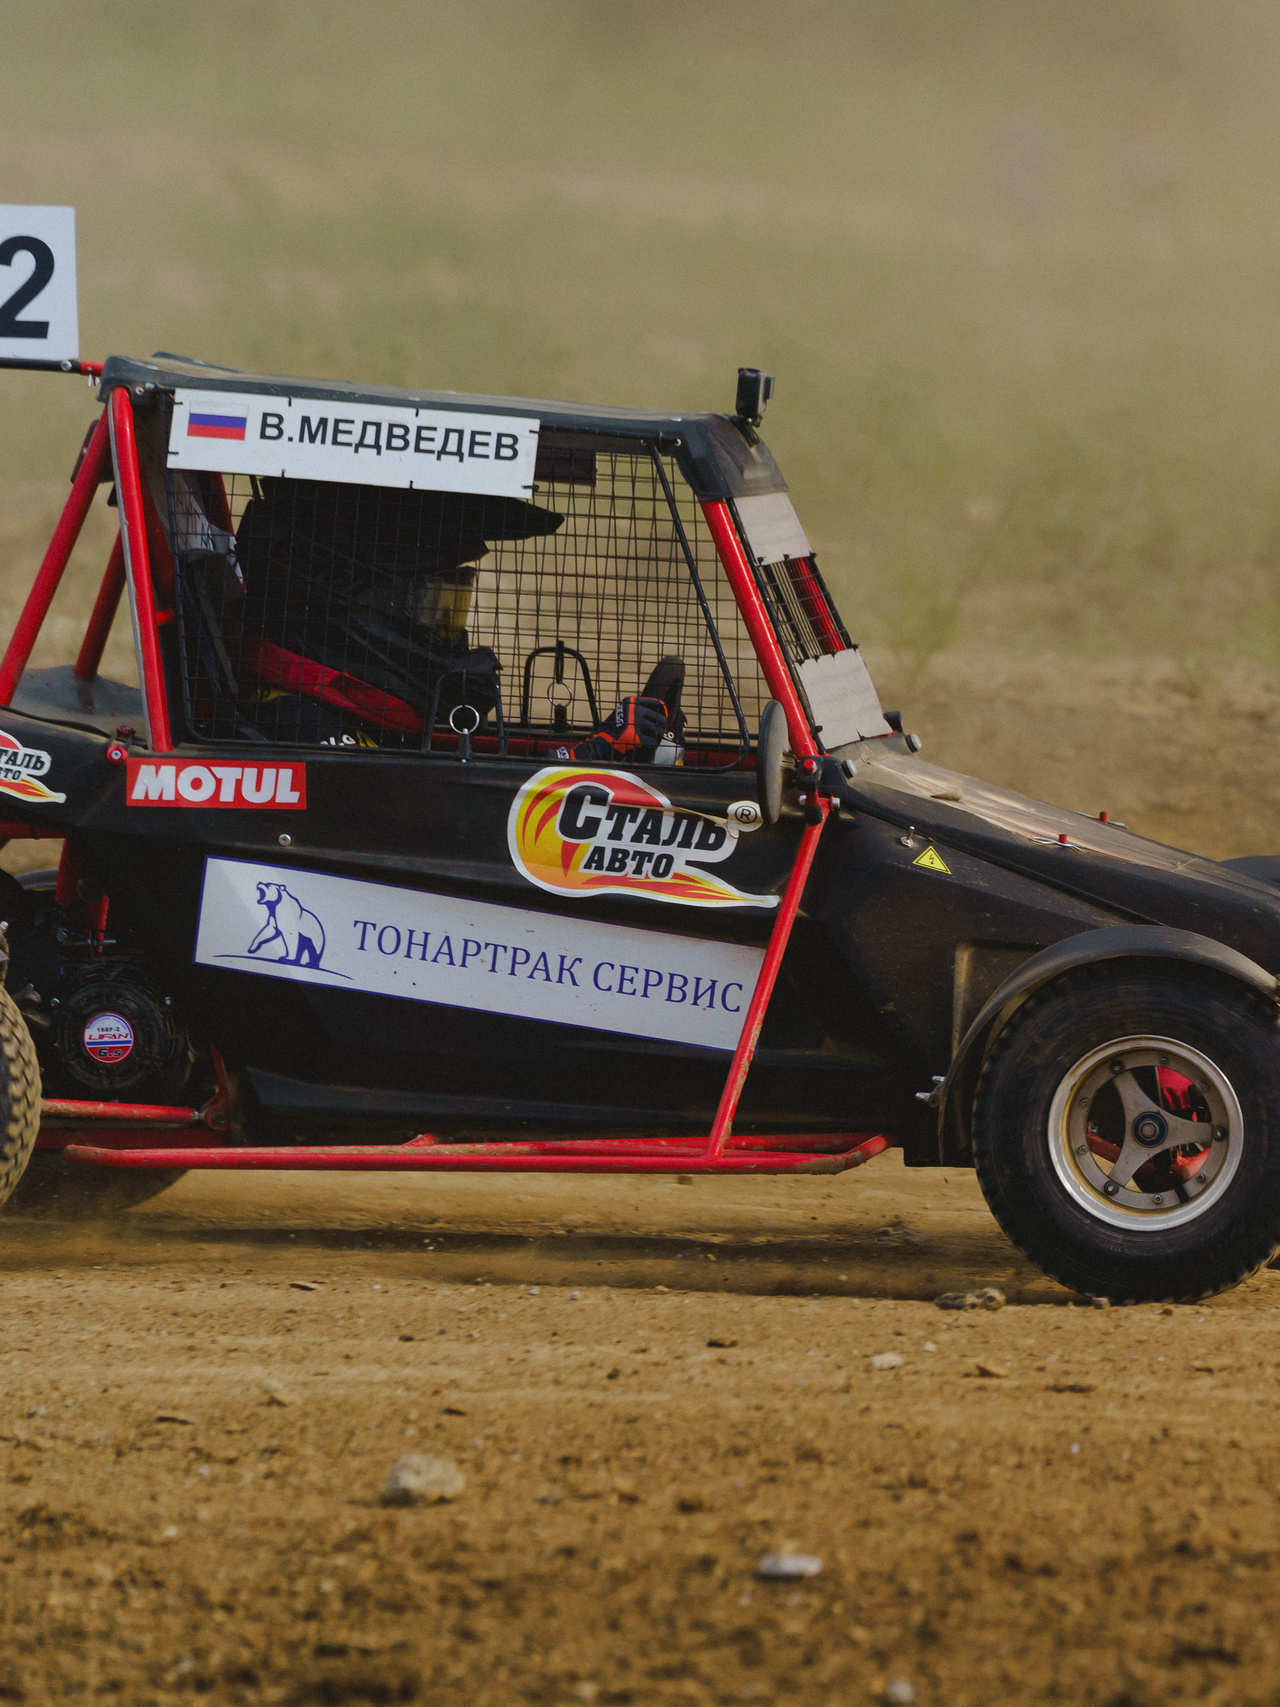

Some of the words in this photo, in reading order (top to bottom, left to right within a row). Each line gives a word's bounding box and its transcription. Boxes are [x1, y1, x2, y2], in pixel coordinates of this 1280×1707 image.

[0, 236, 55, 339] 2
[259, 412, 519, 462] В.МЕДВЕДЕВ
[0, 748, 45, 771] ТАЛЬ
[131, 765, 300, 803] MOTUL
[583, 846, 674, 878] АВТО
[353, 920, 583, 986] ТОНАРТРАК
[593, 962, 743, 1012] СЕРВИС
